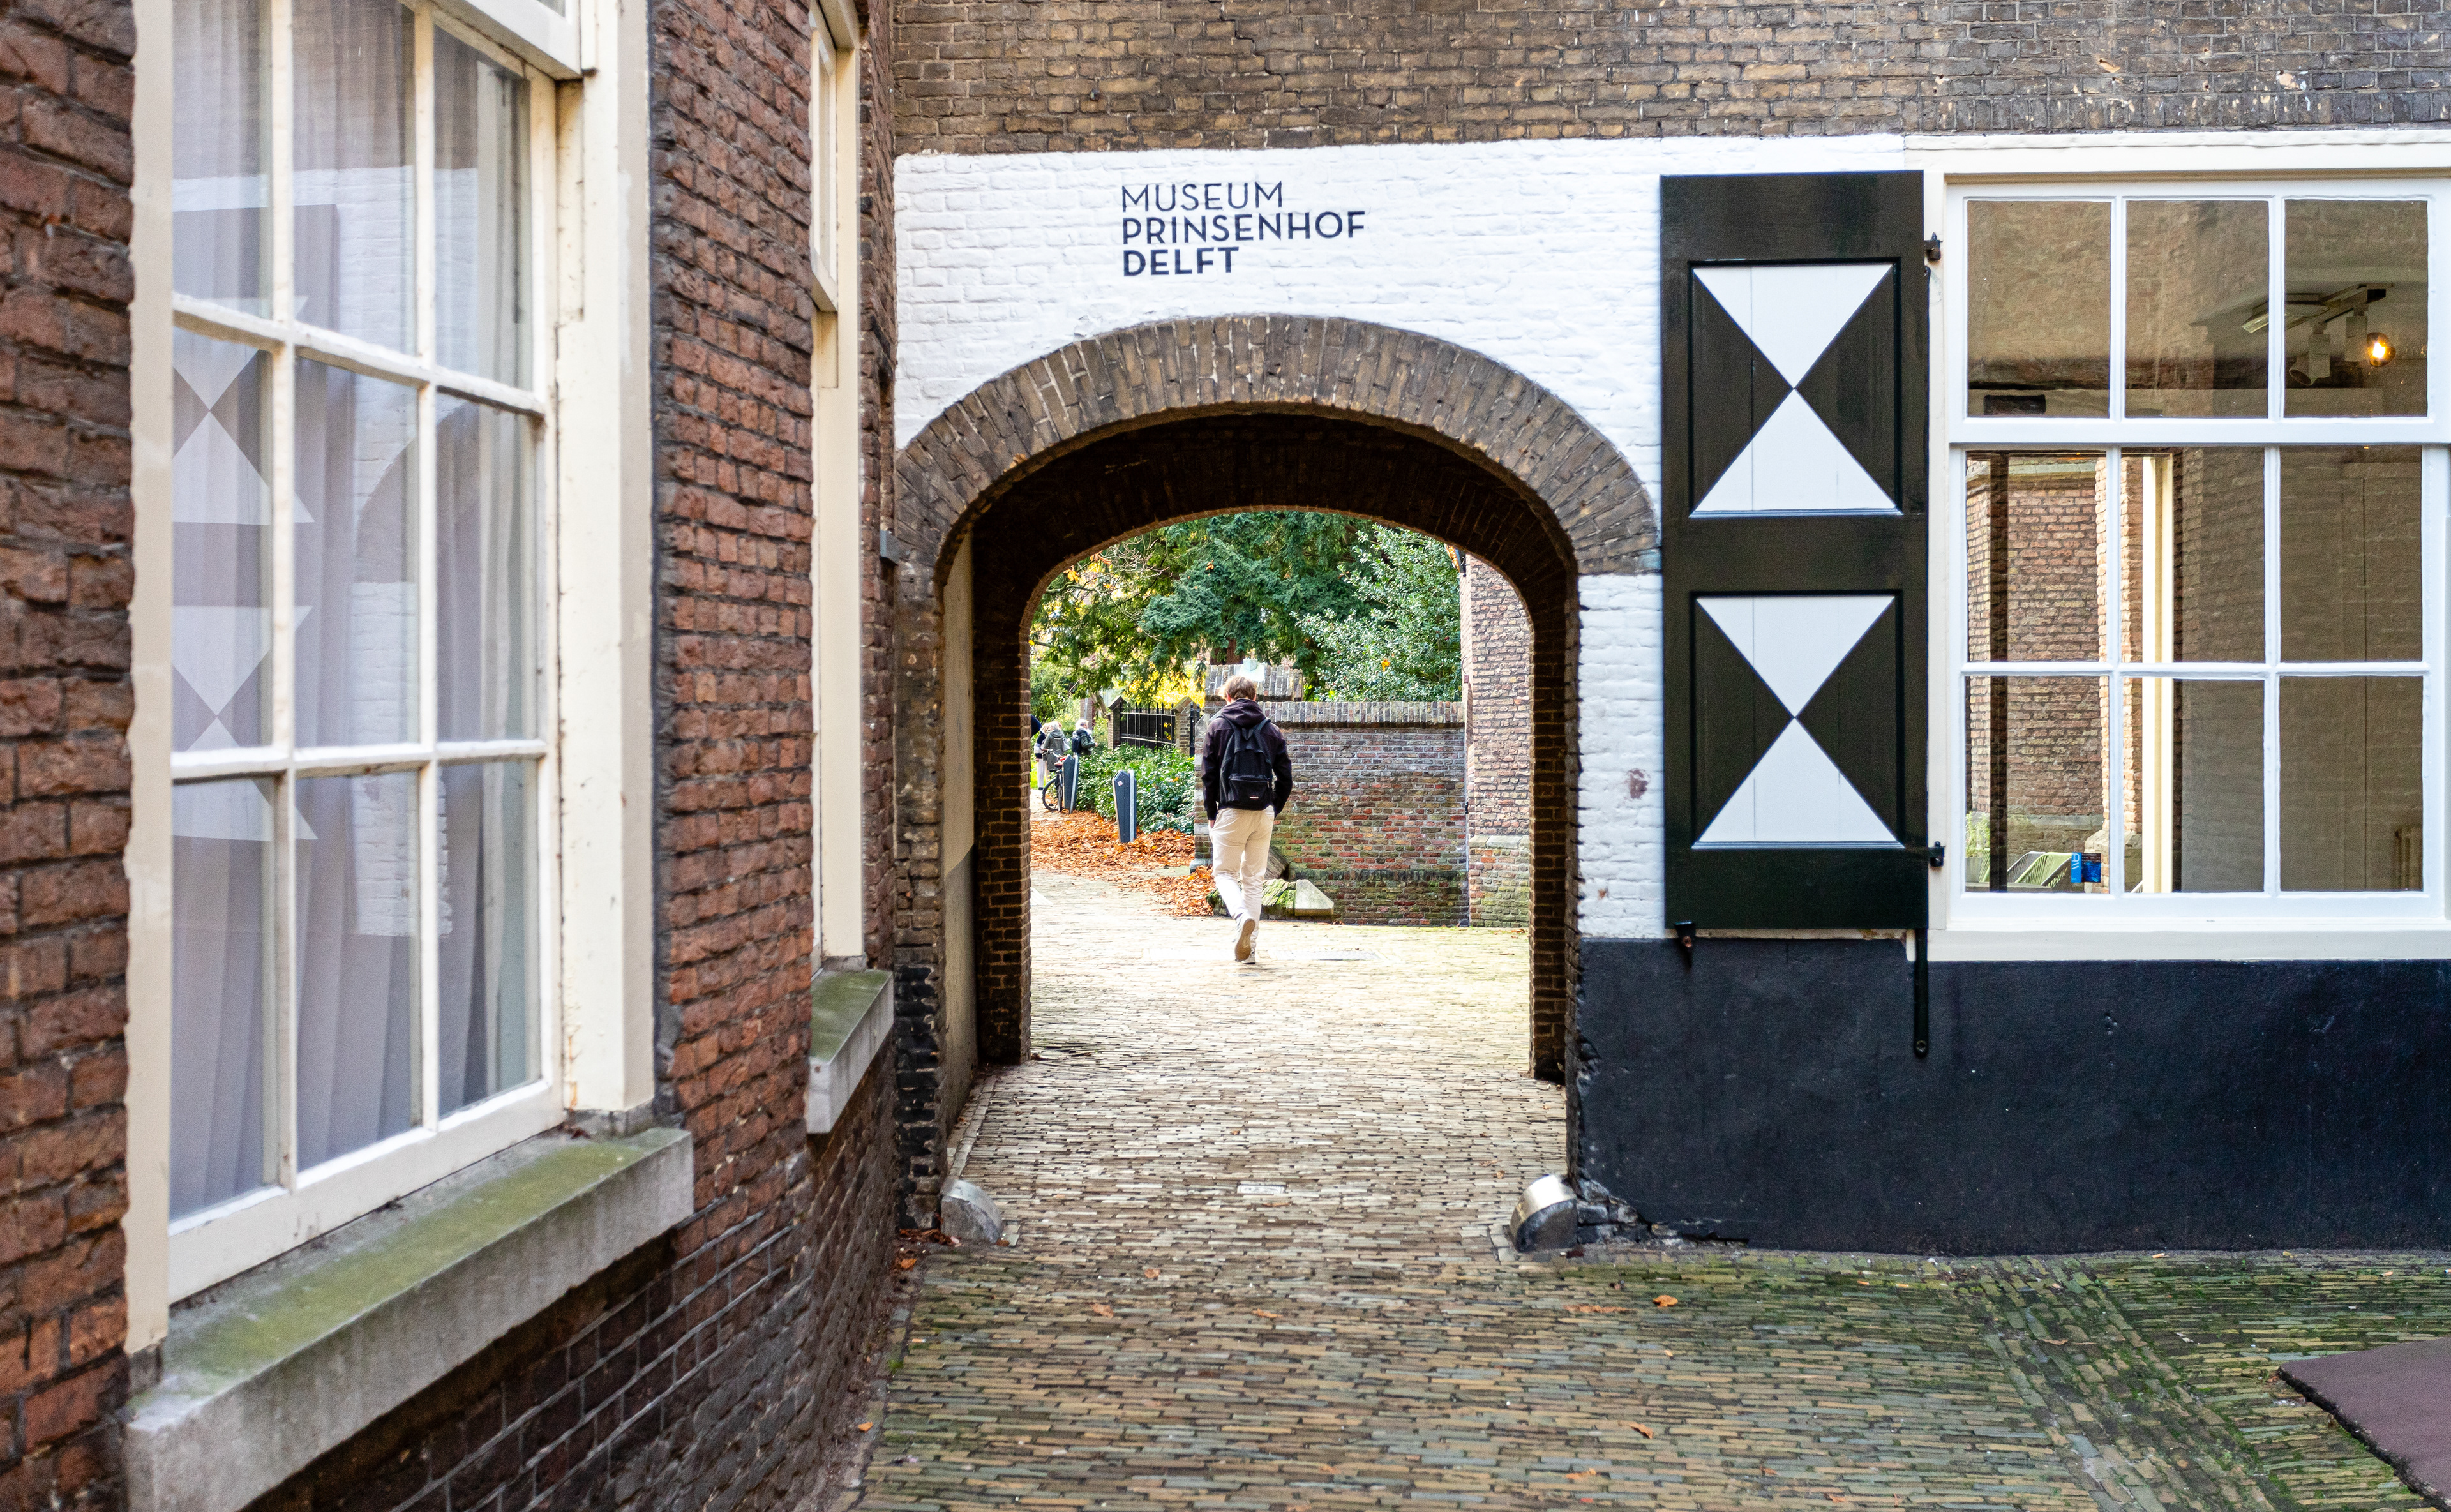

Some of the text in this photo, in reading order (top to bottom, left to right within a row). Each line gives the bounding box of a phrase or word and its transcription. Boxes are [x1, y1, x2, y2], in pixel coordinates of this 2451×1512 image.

[1122, 181, 1282, 213] MUSEUM
[1123, 211, 1365, 244] PRINSENHOF
[1123, 246, 1239, 276] DELFT
